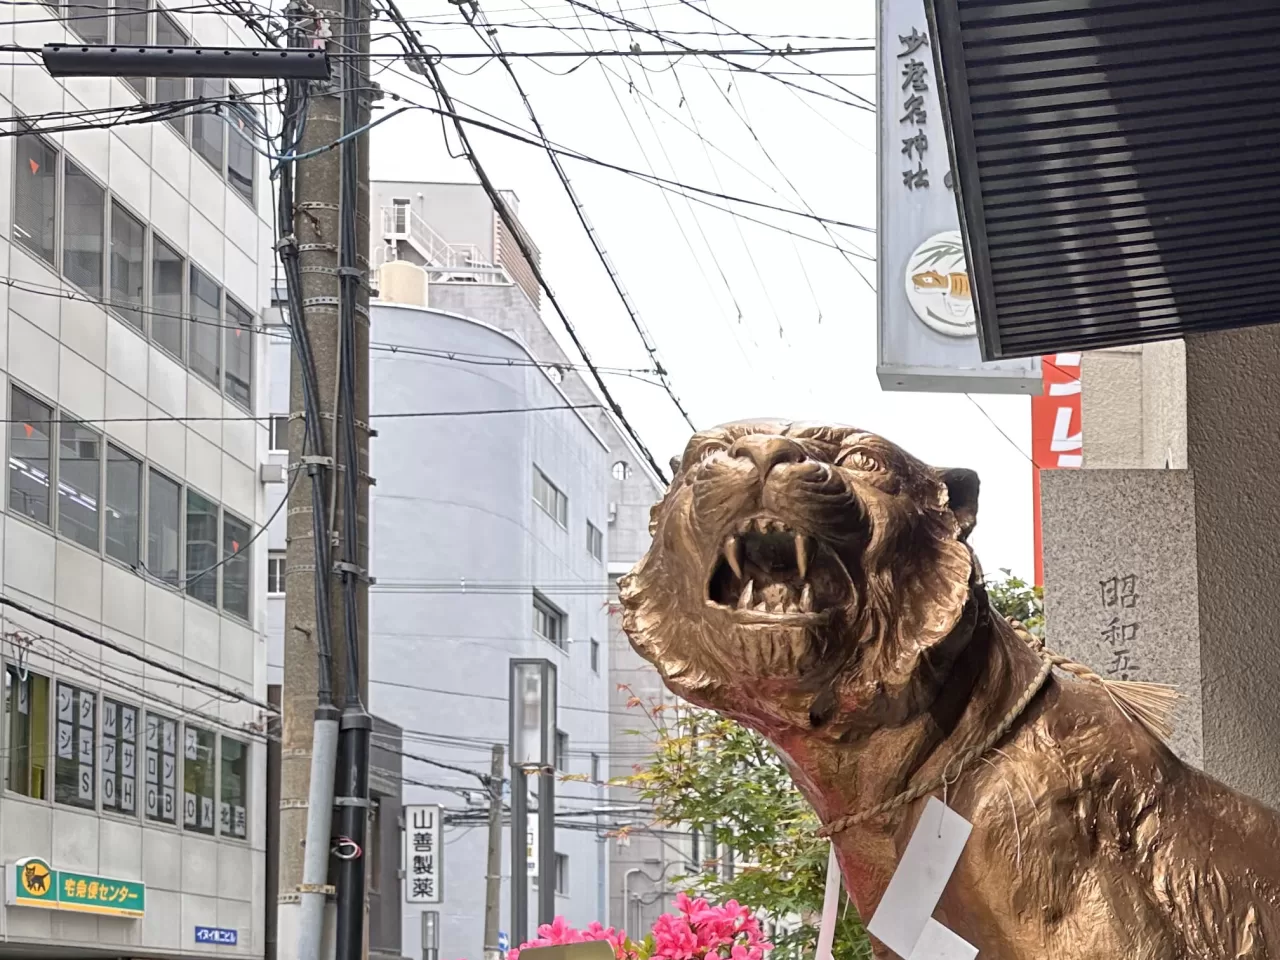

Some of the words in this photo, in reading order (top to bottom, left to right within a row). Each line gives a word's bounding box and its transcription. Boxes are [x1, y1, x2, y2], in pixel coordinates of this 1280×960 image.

[1099, 573, 1142, 681] 昭和五
[65, 878, 138, 903] 宅急便センター
[412, 809, 434, 898] 山善製薬
